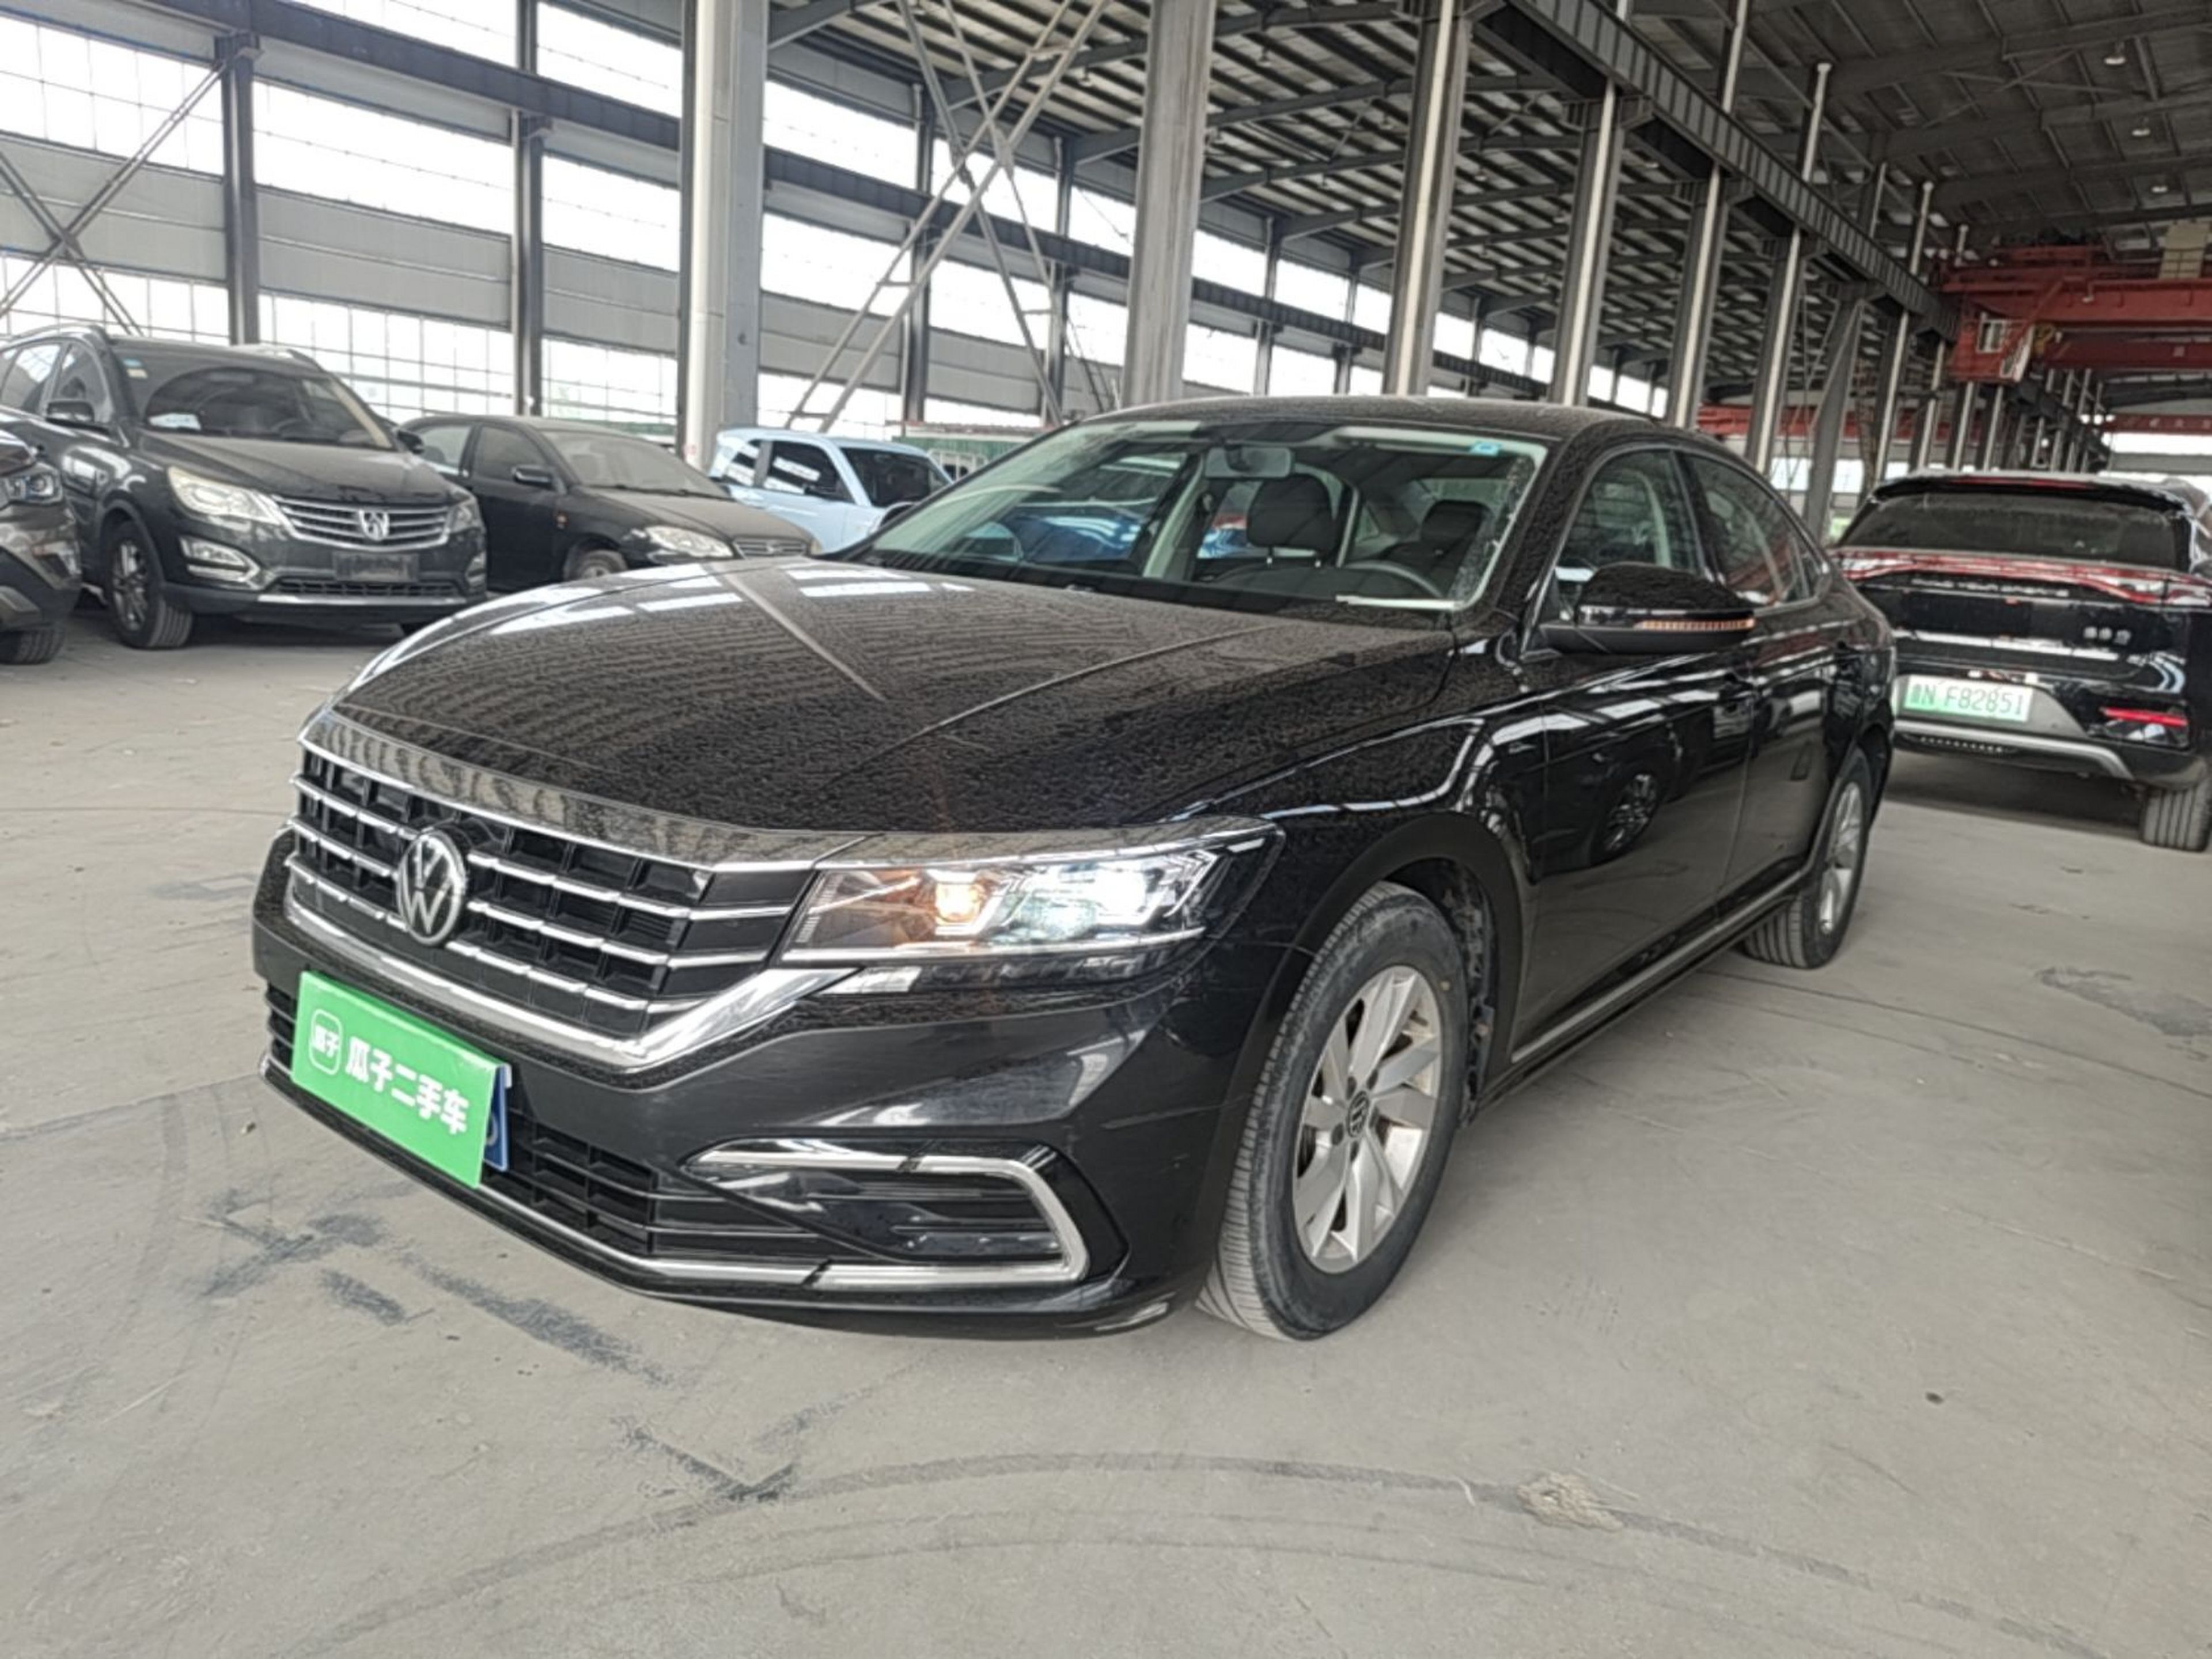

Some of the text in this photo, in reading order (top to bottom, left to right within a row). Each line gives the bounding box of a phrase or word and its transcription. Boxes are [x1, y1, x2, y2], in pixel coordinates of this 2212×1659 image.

[345, 1035, 469, 1134] 瓜子二手车
